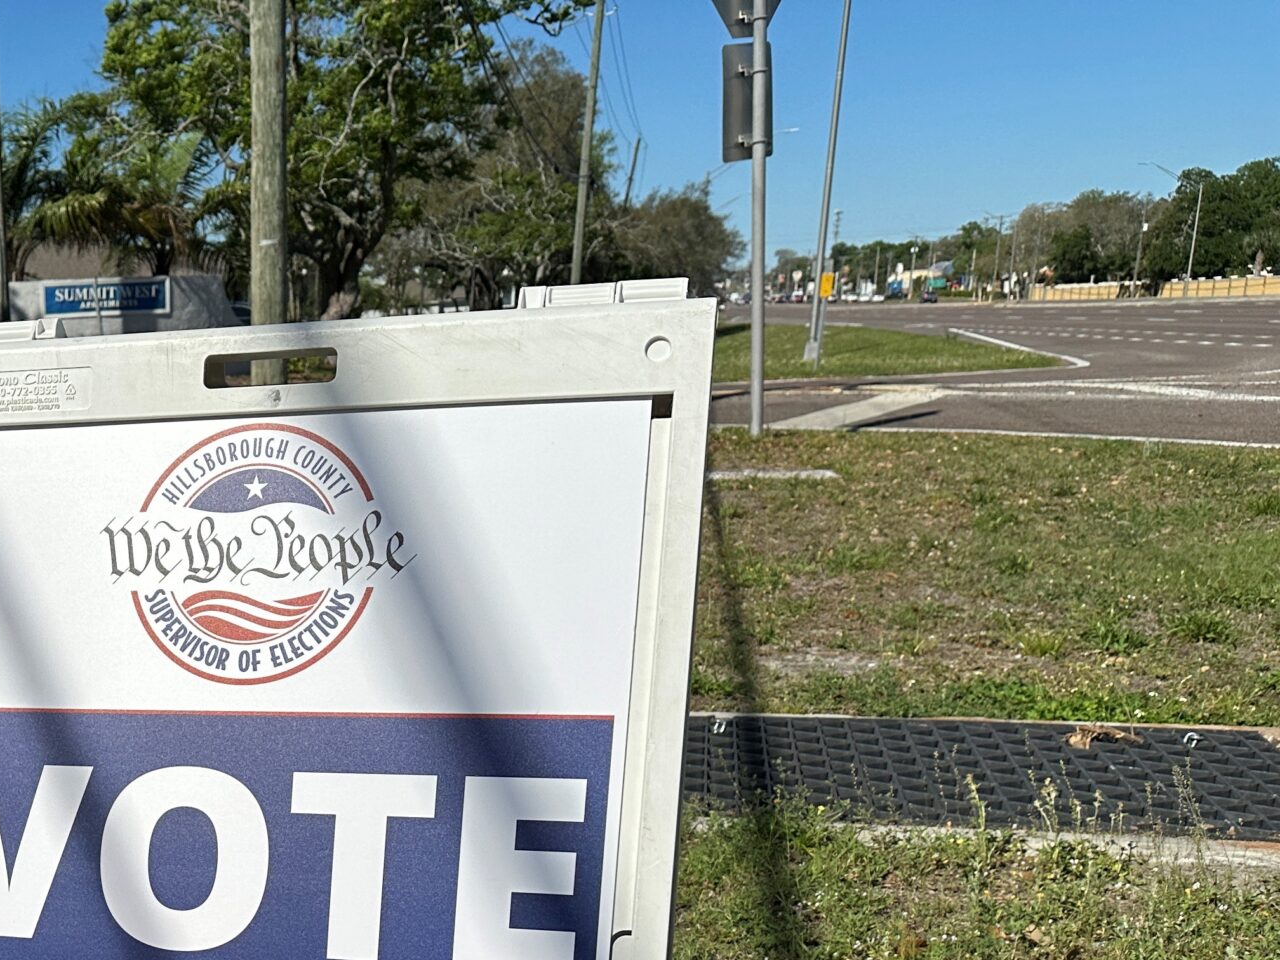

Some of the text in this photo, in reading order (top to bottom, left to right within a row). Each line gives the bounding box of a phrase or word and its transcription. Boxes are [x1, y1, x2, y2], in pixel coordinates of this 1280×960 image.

[54, 284, 159, 302] SUMMIT WEST
[79, 299, 139, 310] APATMENTS
[22, 370, 69, 386] Classic
[161, 437, 353, 505] HILLSBOROUGH COUNTY
[100, 510, 418, 586] We the People
[144, 588, 355, 673] SUPERVISOR OF ELECTIONS
